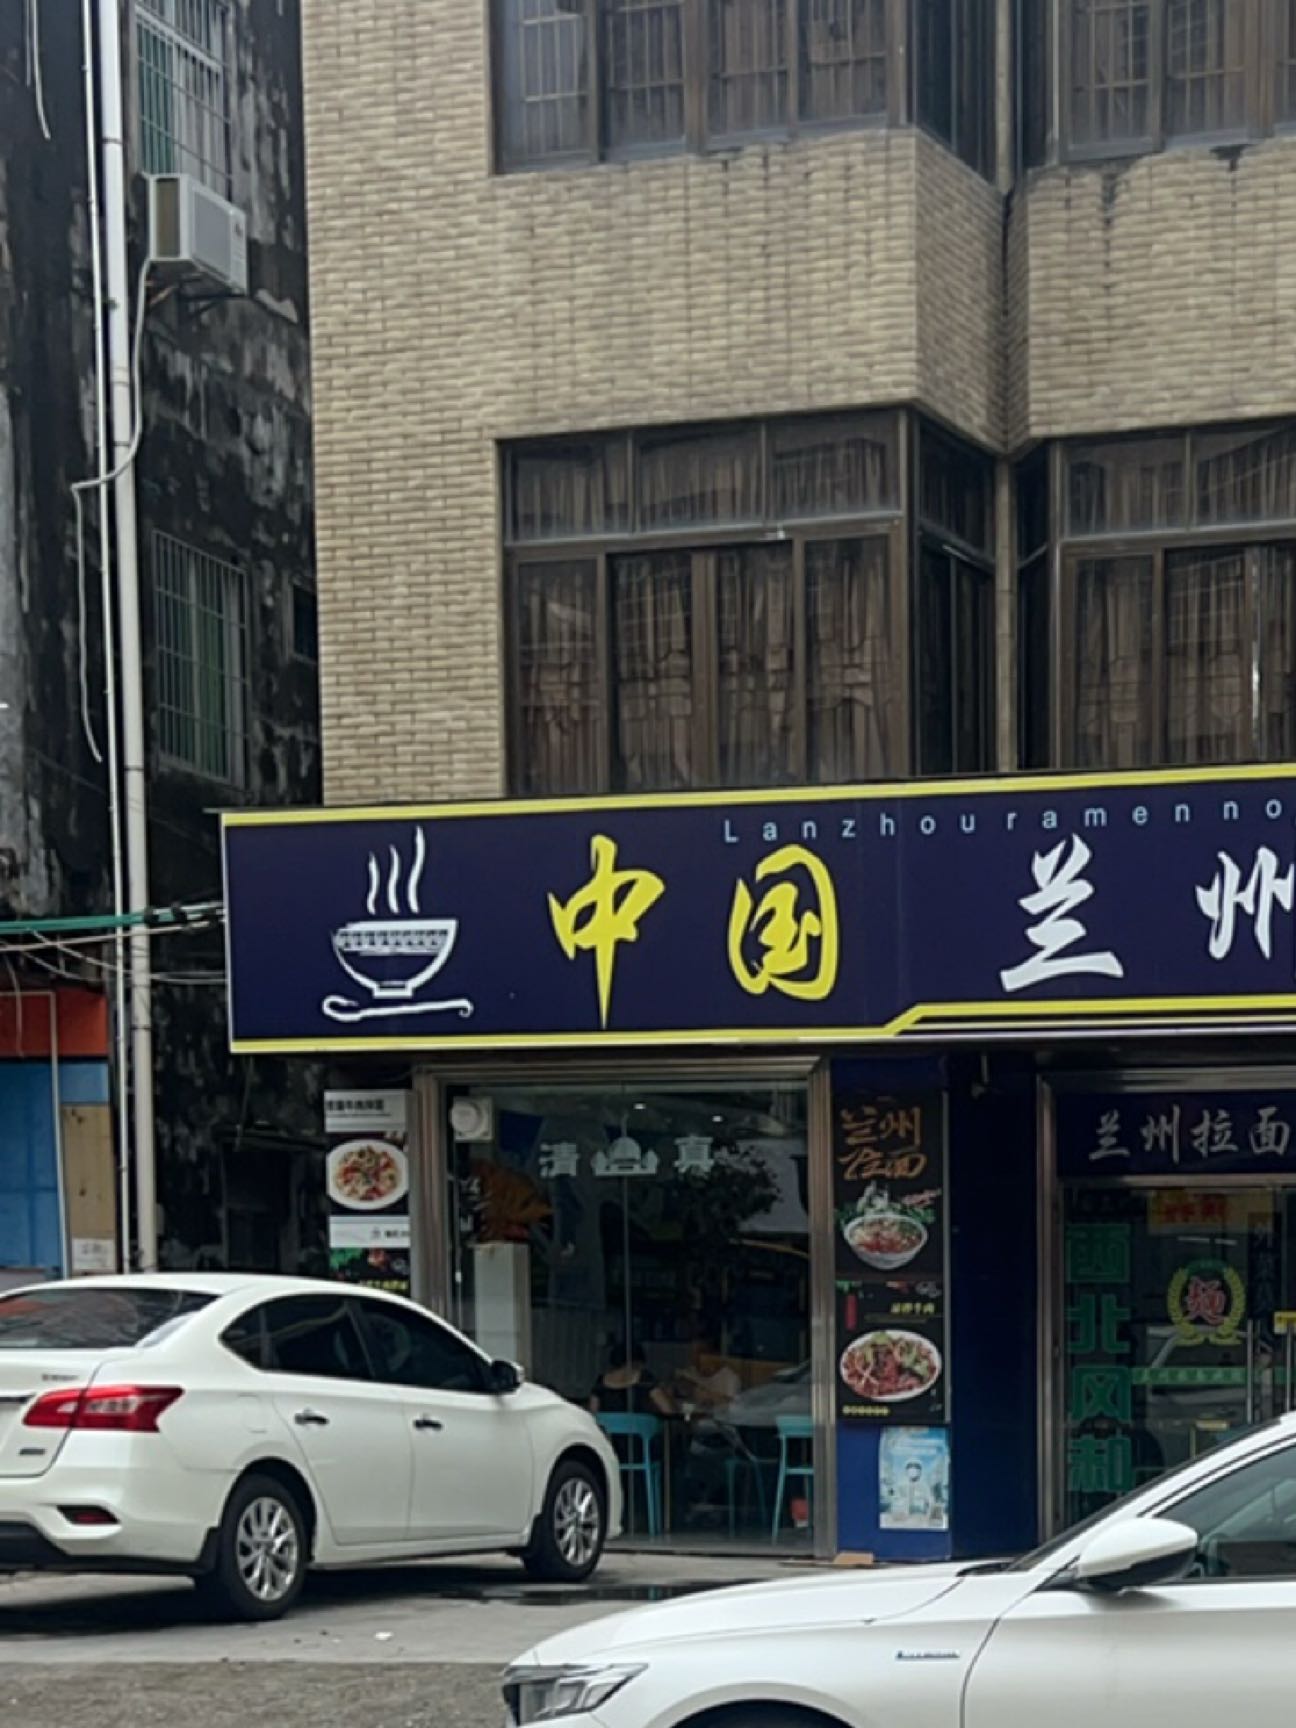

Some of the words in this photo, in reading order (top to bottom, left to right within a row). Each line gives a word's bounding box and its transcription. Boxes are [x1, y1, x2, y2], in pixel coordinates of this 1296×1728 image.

[724, 811, 976, 844] Lanzhou
[1007, 800, 1191, 832] ramen
[548, 833, 839, 1028] 中国
